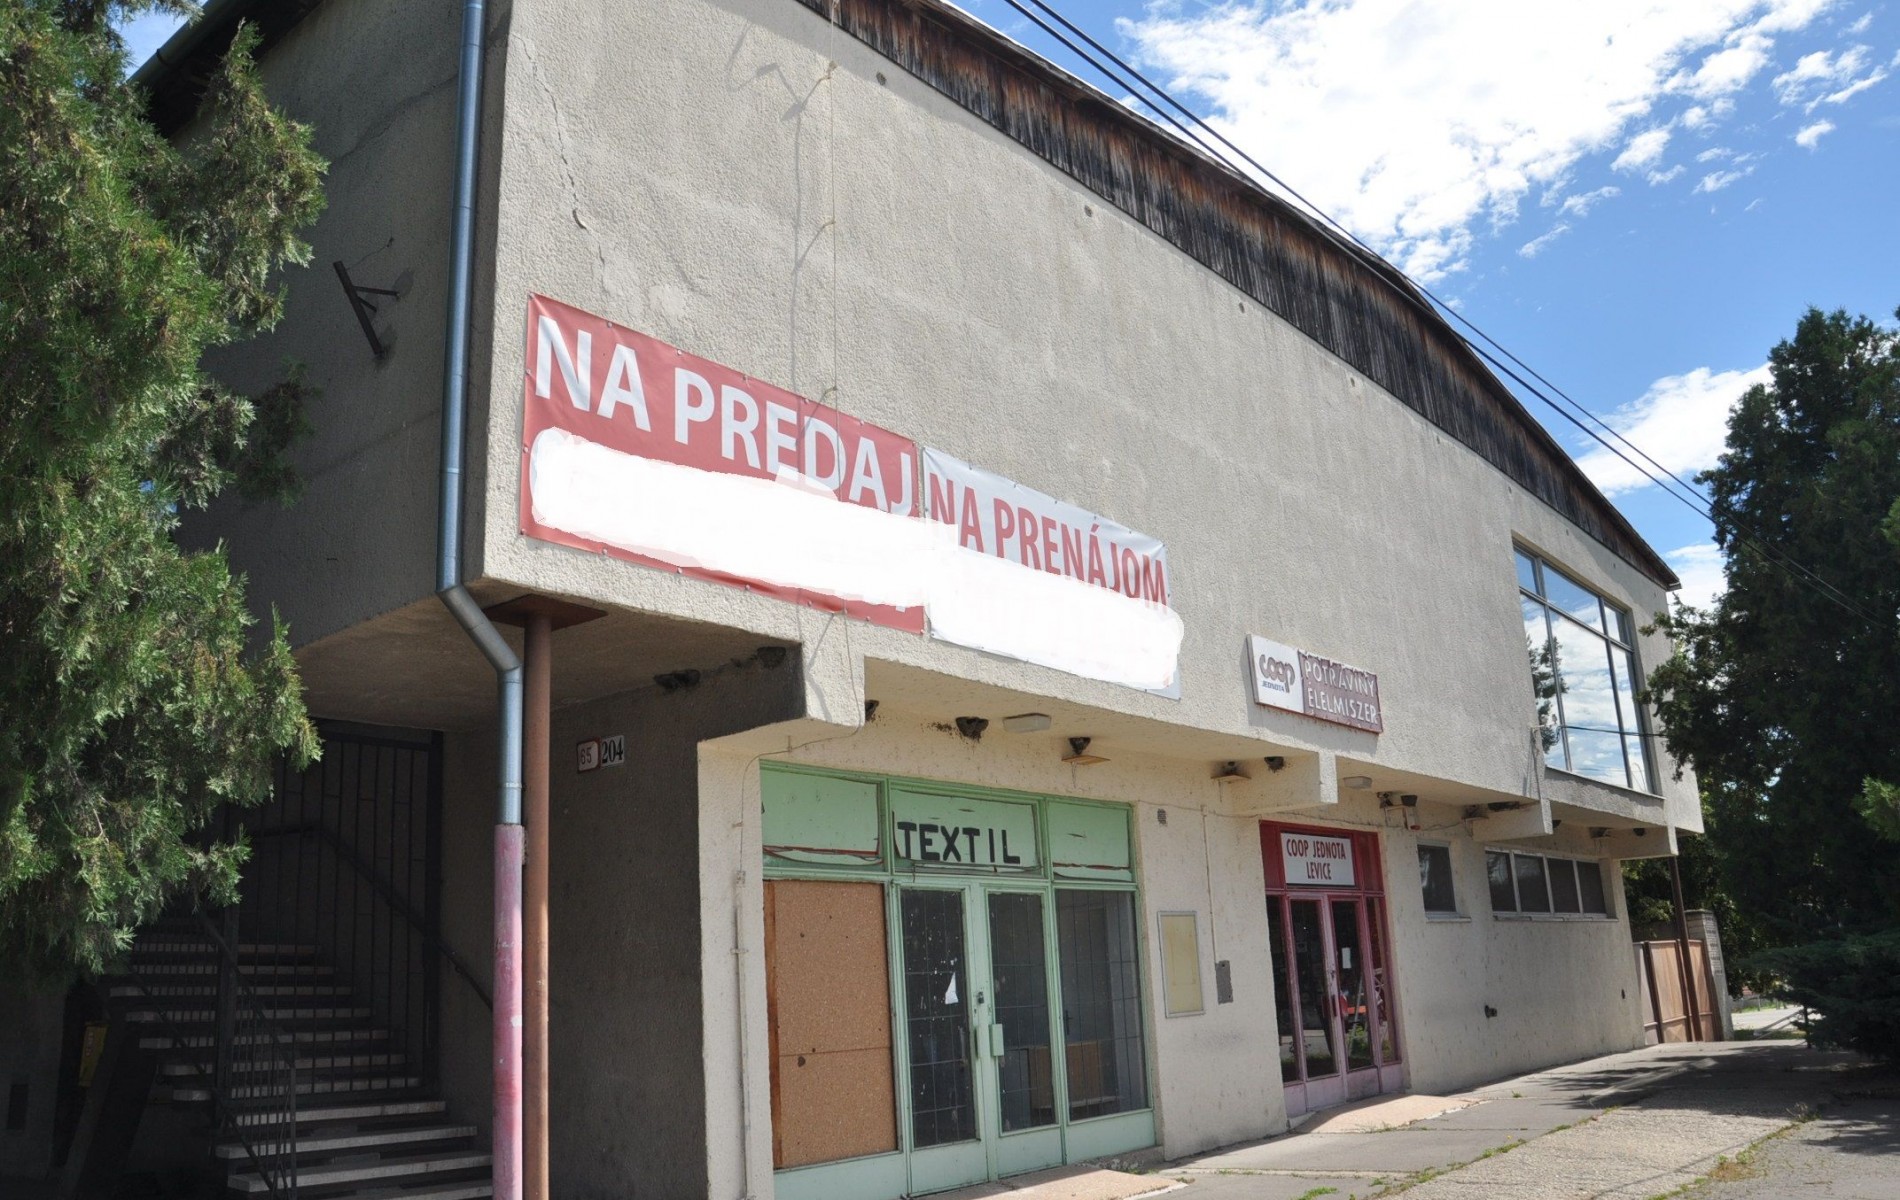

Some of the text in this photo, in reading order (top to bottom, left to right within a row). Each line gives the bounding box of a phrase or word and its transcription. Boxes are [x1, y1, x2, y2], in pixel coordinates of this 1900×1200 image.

[535, 314, 914, 517] NA PREDAJ
[928, 471, 1168, 607] NA PRENÁJOM
[1261, 680, 1286, 693] JEDNOTA
[1304, 660, 1375, 698] POTRAVINY
[601, 737, 624, 764] 204
[897, 821, 1021, 865] TEXTIL
[1286, 838, 1347, 860] COOP JEDNOTA
[1306, 861, 1332, 880] LEVICE
